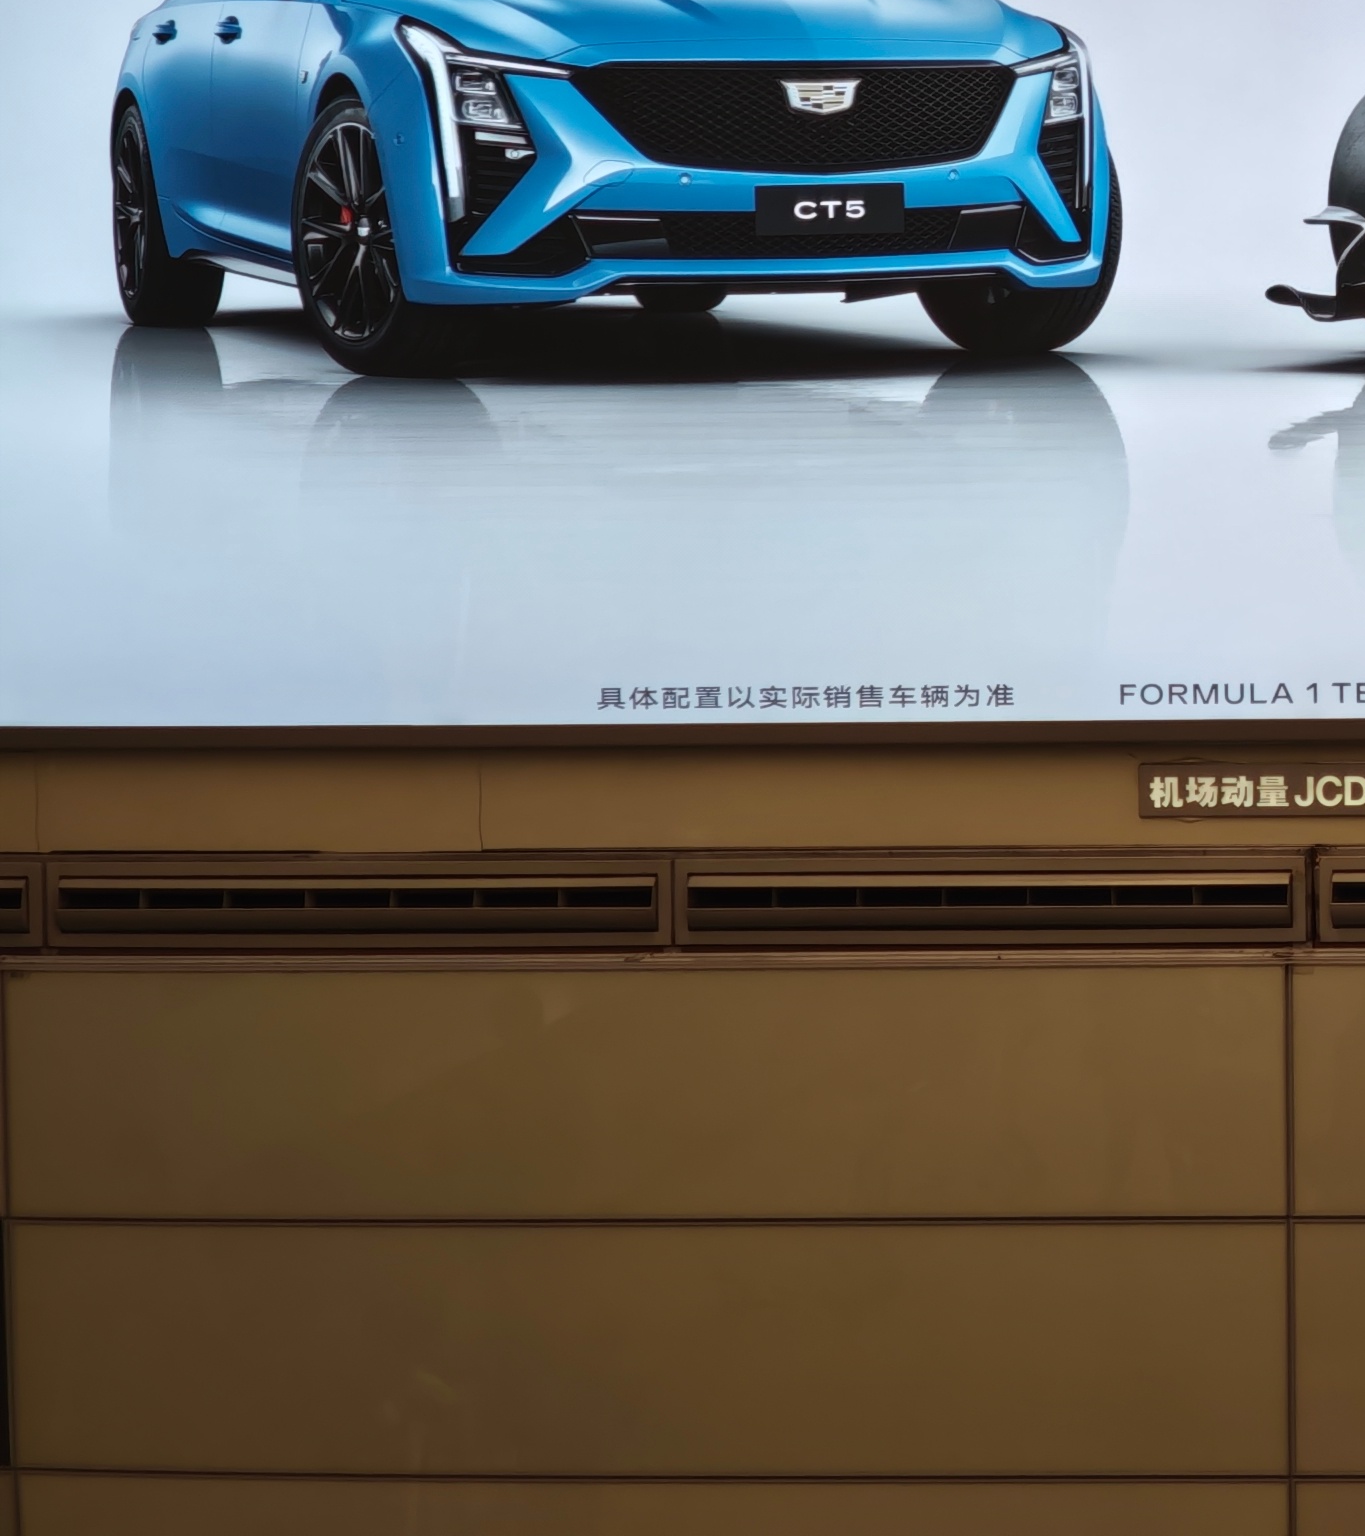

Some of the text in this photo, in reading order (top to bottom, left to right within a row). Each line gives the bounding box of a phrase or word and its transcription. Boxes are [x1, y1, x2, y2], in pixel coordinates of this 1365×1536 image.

[793, 199, 866, 220] CT5
[597, 683, 1015, 711] 具体配置以实际销售车辆为准
[1119, 681, 1294, 706] FORMULA
[1306, 682, 1319, 705] 1
[1149, 774, 1290, 810] 机场动量
